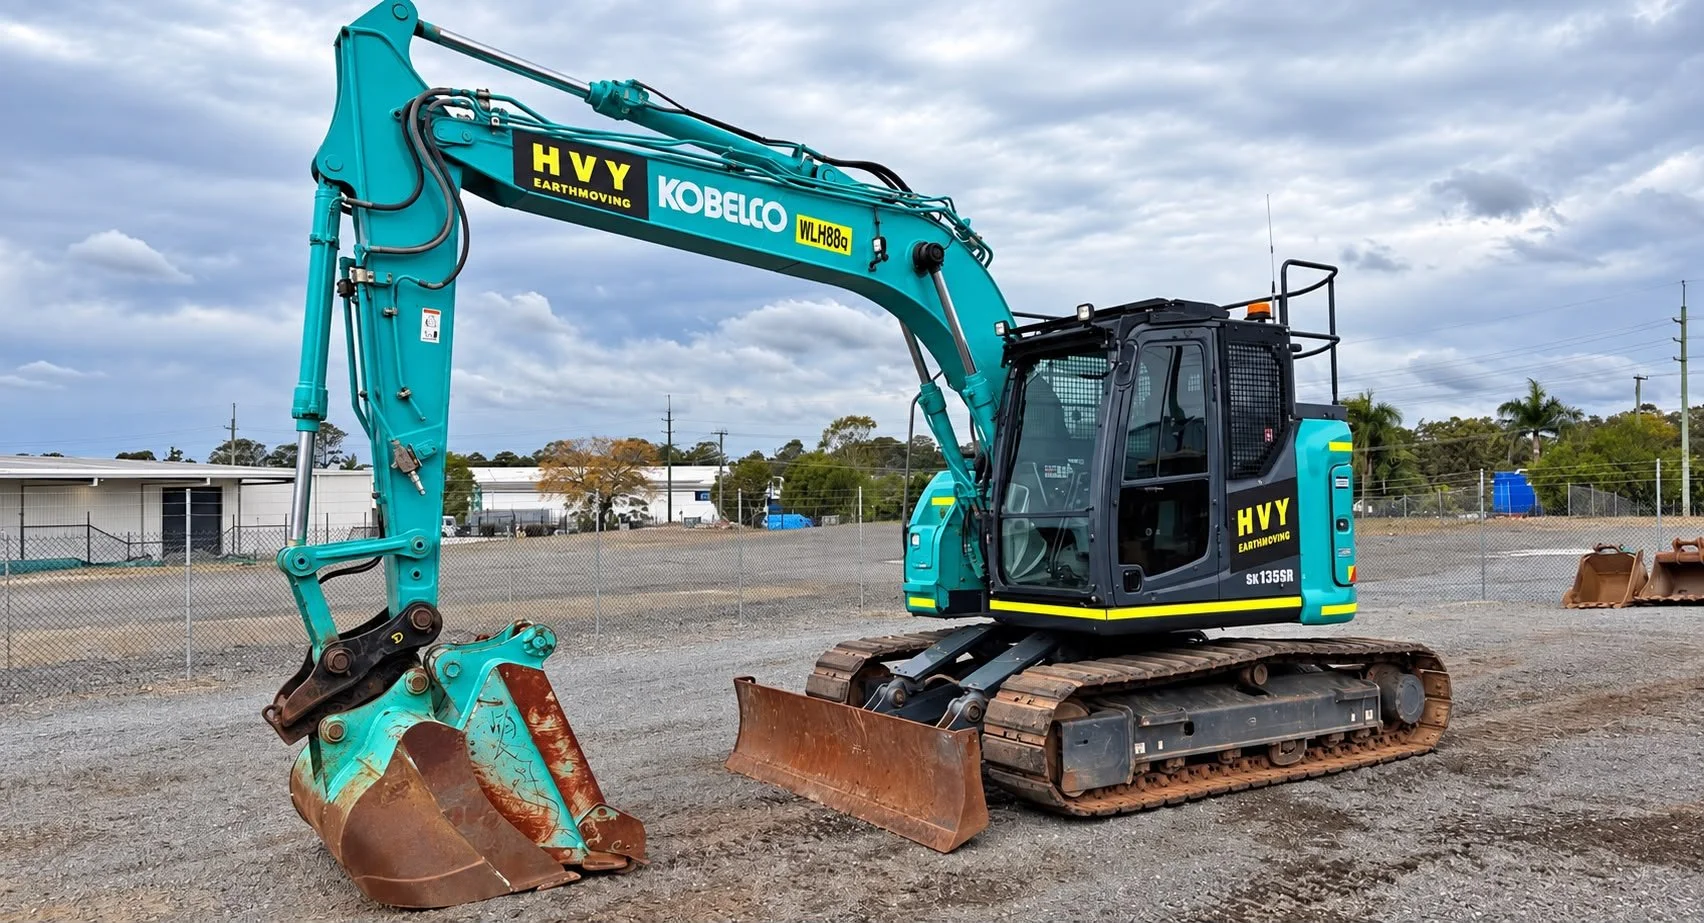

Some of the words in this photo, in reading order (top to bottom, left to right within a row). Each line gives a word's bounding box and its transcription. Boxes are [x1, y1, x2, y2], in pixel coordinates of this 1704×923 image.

[533, 143, 631, 191] HVY
[533, 177, 631, 208] EARTHMOVING
[658, 175, 788, 233] KOBELCO
[1237, 497, 1290, 537] HVY
[1238, 531, 1291, 553] EARTHMOVING
